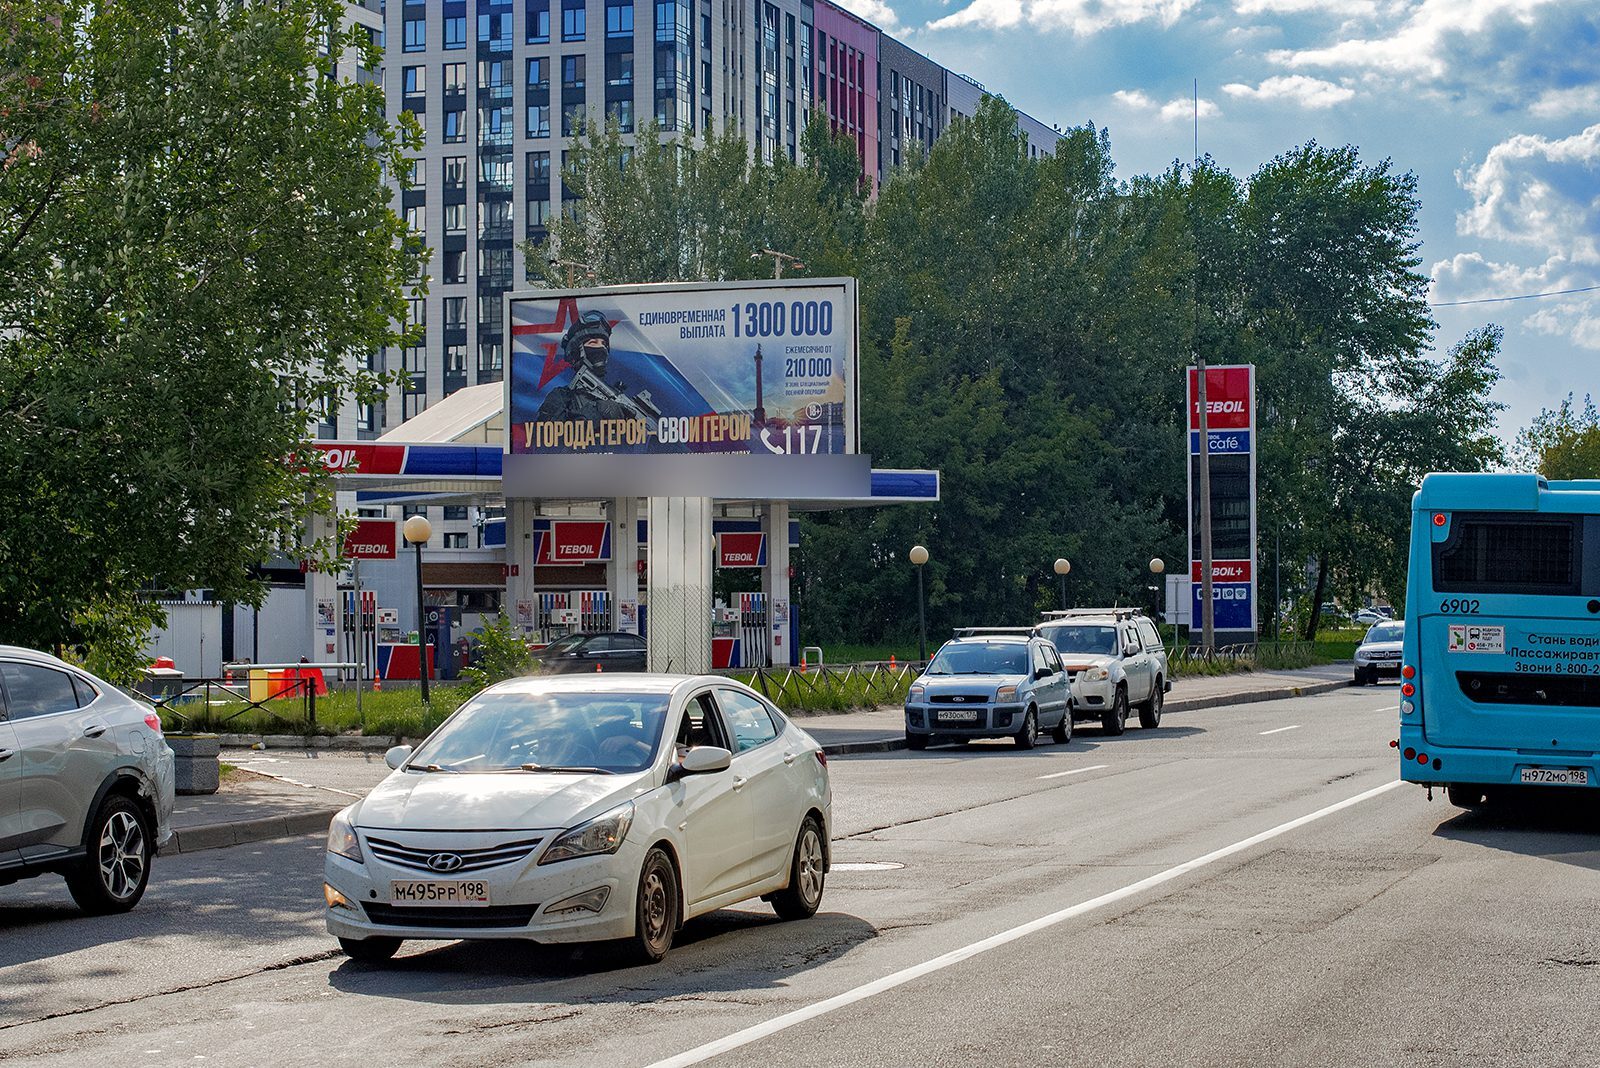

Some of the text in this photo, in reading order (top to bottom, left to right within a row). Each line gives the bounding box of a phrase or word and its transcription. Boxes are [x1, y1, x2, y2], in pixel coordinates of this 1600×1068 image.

[639, 309, 726, 326] ЕДИНОВРЕМЕННАЯ
[731, 300, 833, 338] 1 300 000
[680, 325, 726, 339] ВЫПЛАТА
[785, 345, 832, 354] ЕЖЕМЕСЯЧНО ОТ
[785, 358, 832, 377] 210 000
[808, 404, 821, 417] 18+
[524, 422, 535, 448] У
[702, 414, 751, 443] ГЕРОИ
[782, 425, 822, 455] 117
[1209, 437, 1238, 450] café
[352, 543, 389, 554] TEBOIL
[560, 544, 595, 554] TEBOIL
[724, 553, 753, 562] TEBOIL
[1440, 599, 1480, 614] 6902
[1527, 633, 1566, 645] Стань
[1514, 661, 1552, 673] Звони
[1524, 770, 1585, 782] Н972МО 198
[395, 882, 484, 900] М495РР 198
